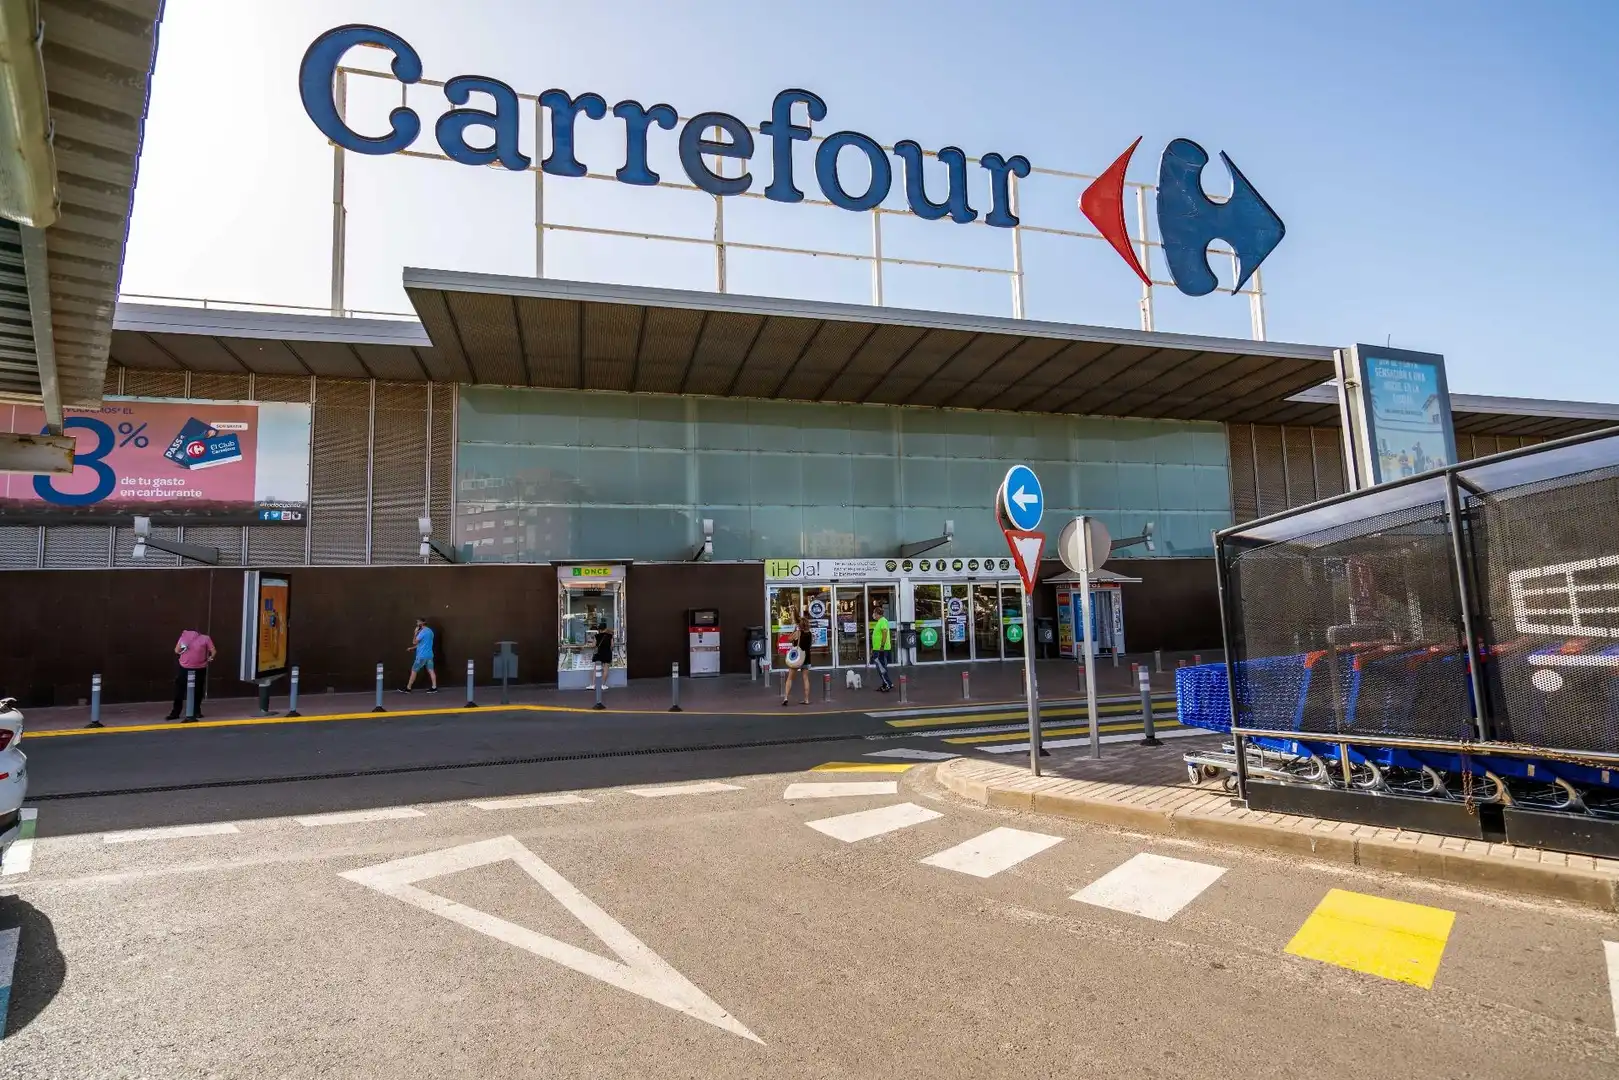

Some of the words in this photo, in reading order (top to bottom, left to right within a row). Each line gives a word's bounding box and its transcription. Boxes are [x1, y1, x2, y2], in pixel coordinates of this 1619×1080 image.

[299, 23, 1031, 229] Carrefour
[122, 407, 134, 415] EL
[218, 440, 235, 449] Club
[120, 476, 136, 485] de
[138, 477, 151, 485] tu
[152, 477, 186, 488] gasto
[120, 489, 135, 497] en
[136, 488, 203, 498] carburante
[772, 561, 820, 577] ¡Hola!
